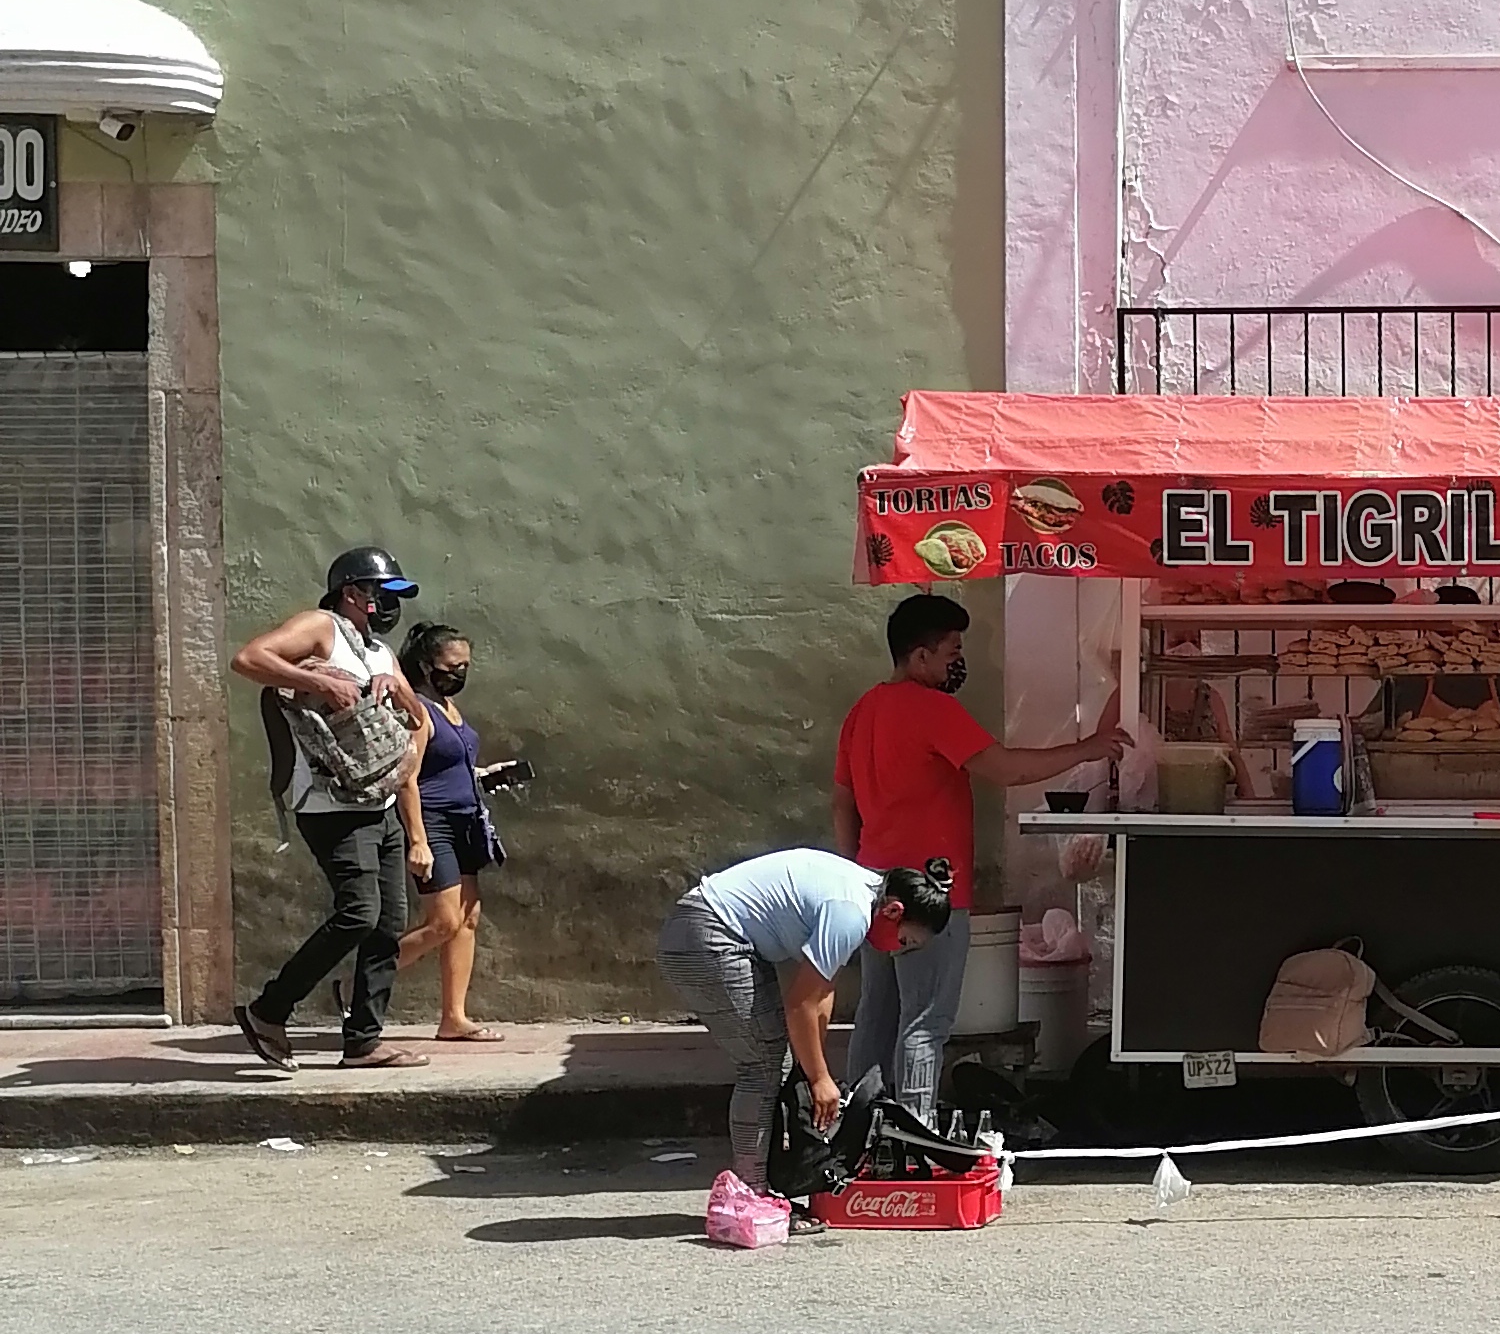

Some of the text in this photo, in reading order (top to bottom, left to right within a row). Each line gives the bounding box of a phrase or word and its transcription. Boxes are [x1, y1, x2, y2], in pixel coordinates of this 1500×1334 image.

[872, 482, 994, 516] TORTAS
[1162, 489, 1253, 567] EL
[998, 541, 1098, 570] TACOS
[845, 1190, 921, 1218] Coca-Cola
